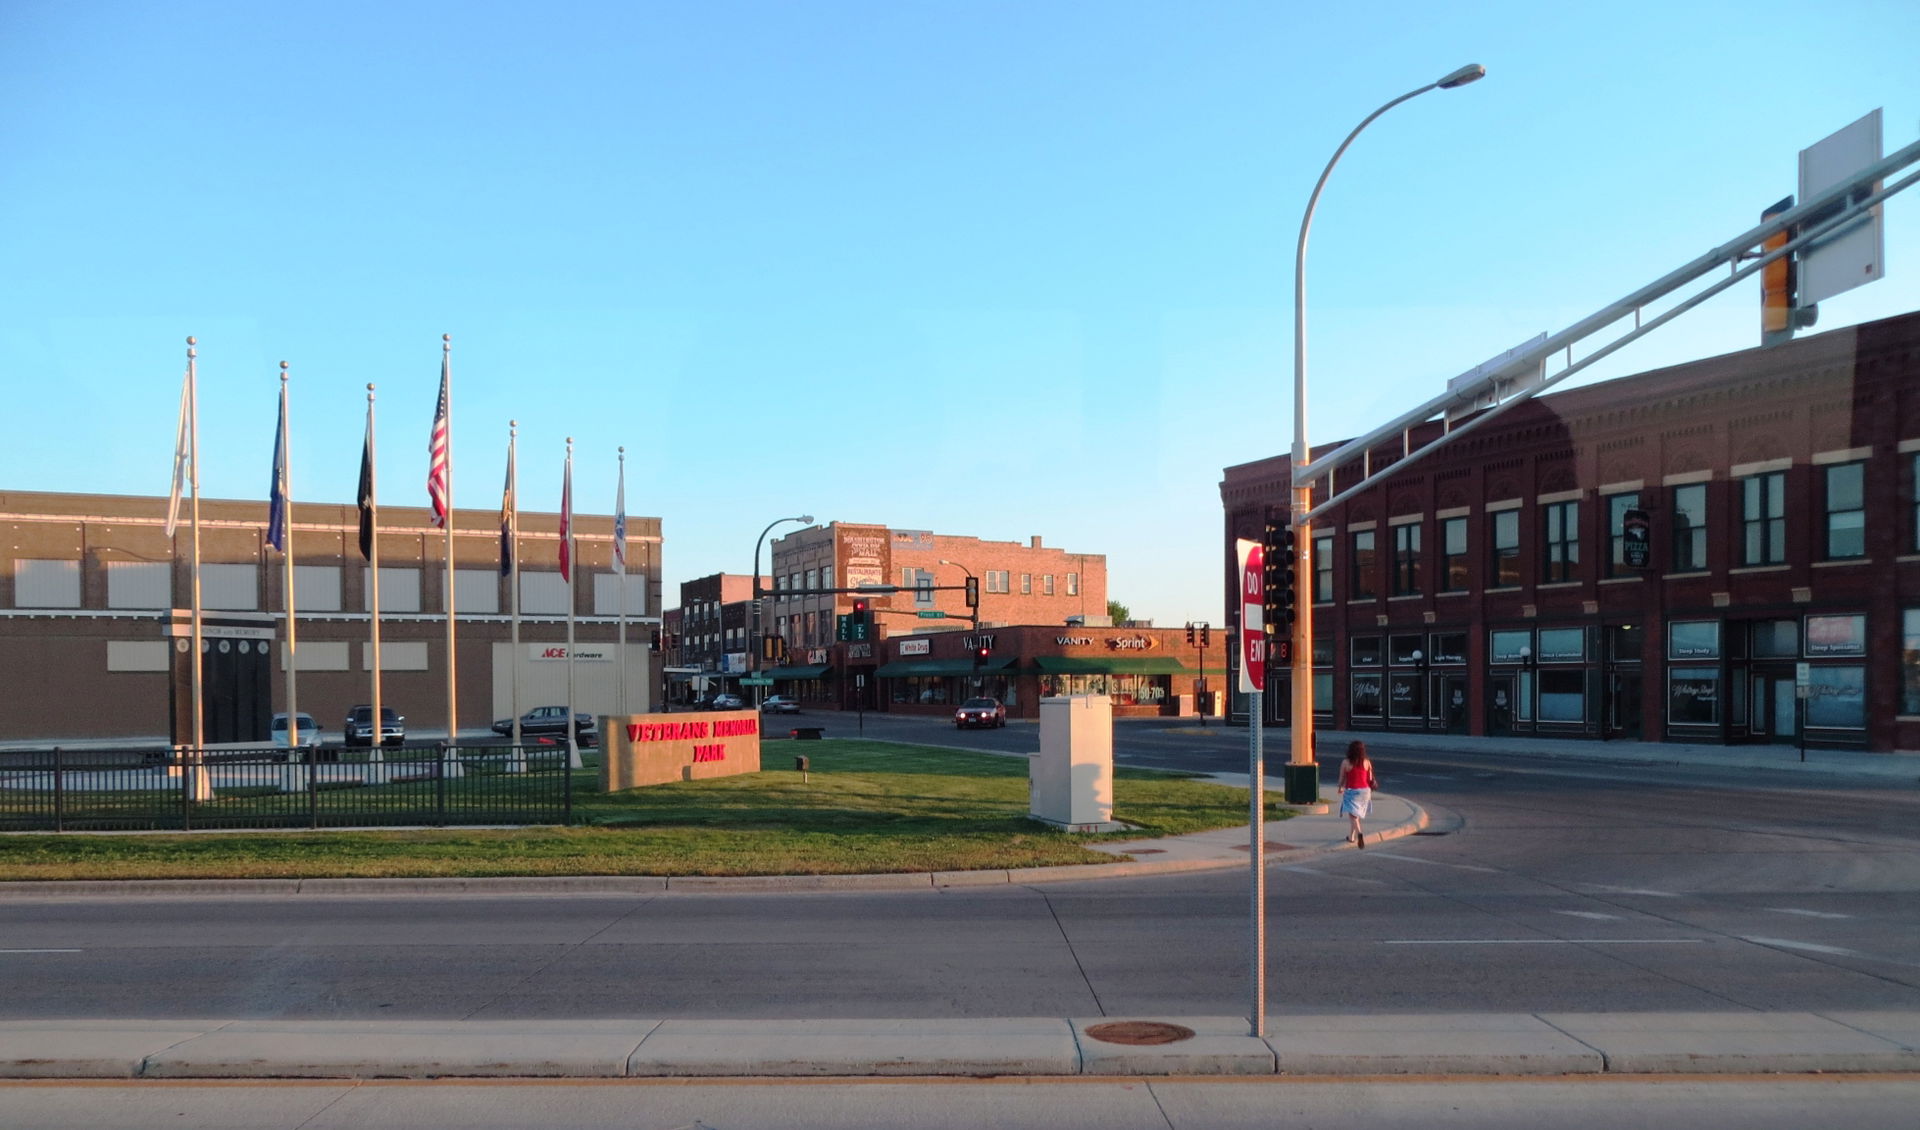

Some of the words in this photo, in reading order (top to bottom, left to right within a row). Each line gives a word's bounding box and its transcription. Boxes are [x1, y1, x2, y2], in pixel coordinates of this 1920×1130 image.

[1624, 542, 1648, 551] PIZZA
[1247, 571, 1258, 596] DO
[963, 635, 994, 651] VAITY
[1056, 637, 1094, 646] VANITY
[1115, 636, 1145, 651] Sprint
[541, 648, 566, 658] ACE
[566, 651, 603, 659] ardware
[1250, 639, 1266, 662] ENT
[1281, 643, 1287, 658] 8
[626, 722, 709, 742] VETERANS
[713, 719, 757, 738] MEMORIAL
[693, 744, 726, 763] PARK
